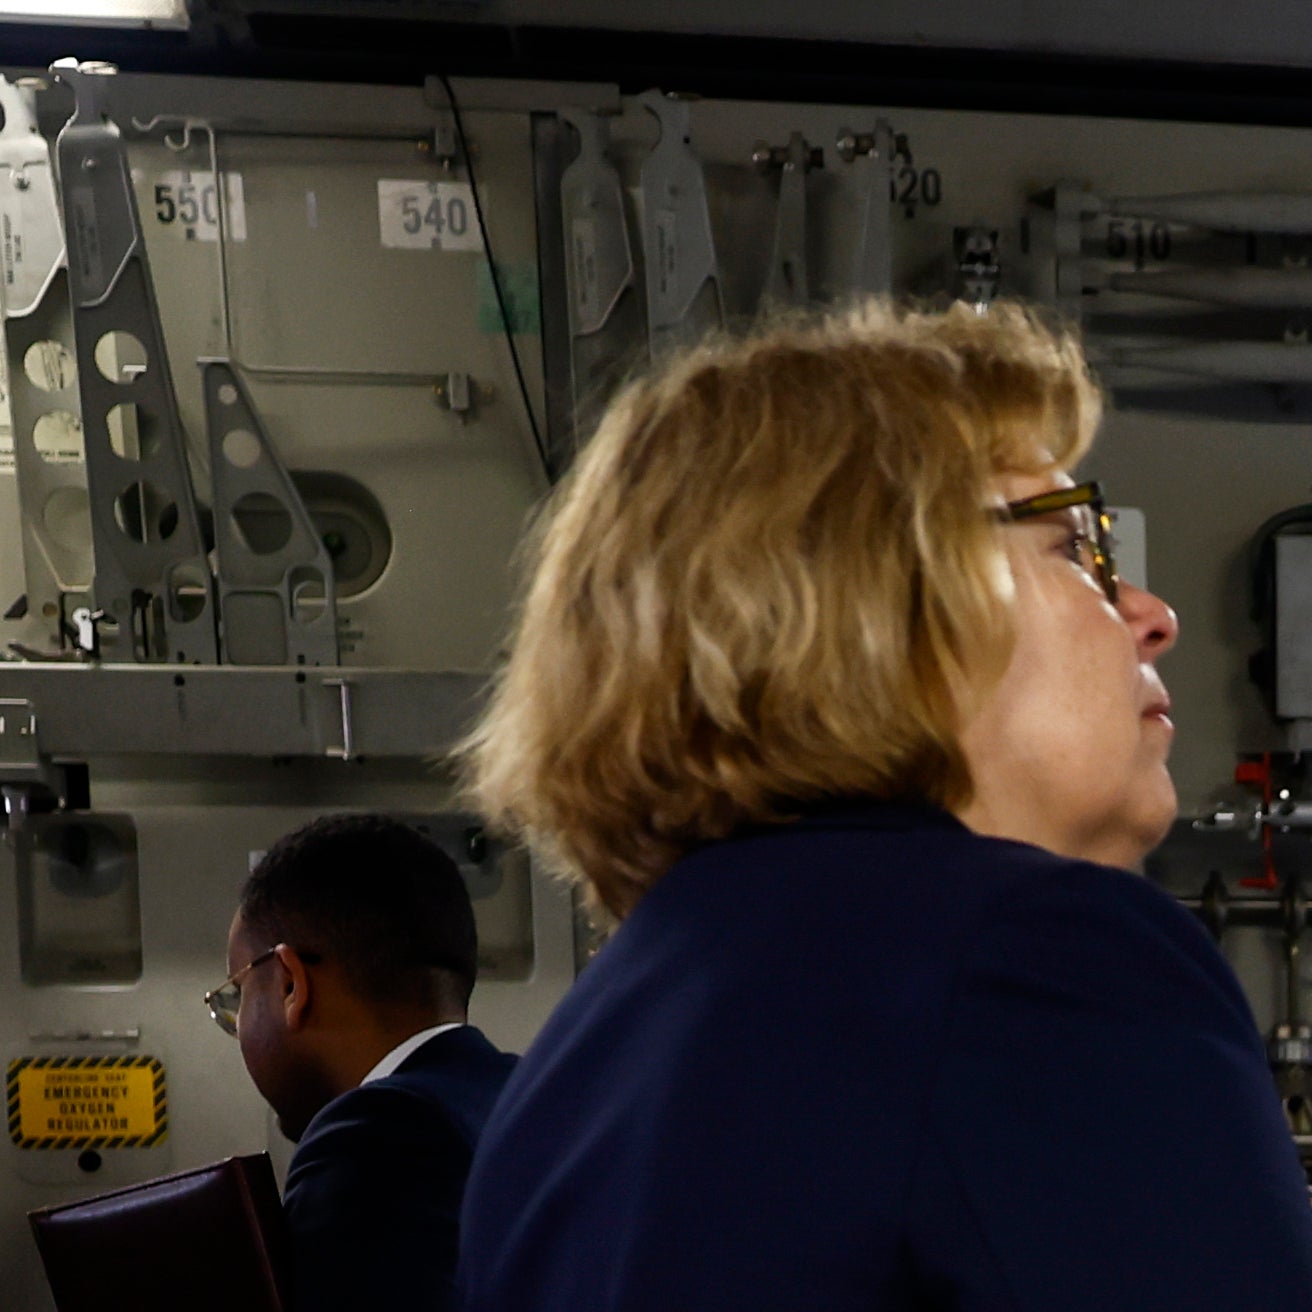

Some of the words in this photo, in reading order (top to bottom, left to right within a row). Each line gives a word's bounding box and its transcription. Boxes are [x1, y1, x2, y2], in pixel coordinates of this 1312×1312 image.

[155, 184, 217, 225] 550
[889, 169, 942, 206] 20
[402, 195, 467, 236] 540
[1106, 221, 1172, 260] 510
[44, 1087, 128, 1099] EMERGENCY
[59, 1103, 115, 1114] OXYGEN
[48, 1118, 128, 1130] REGULATOR
